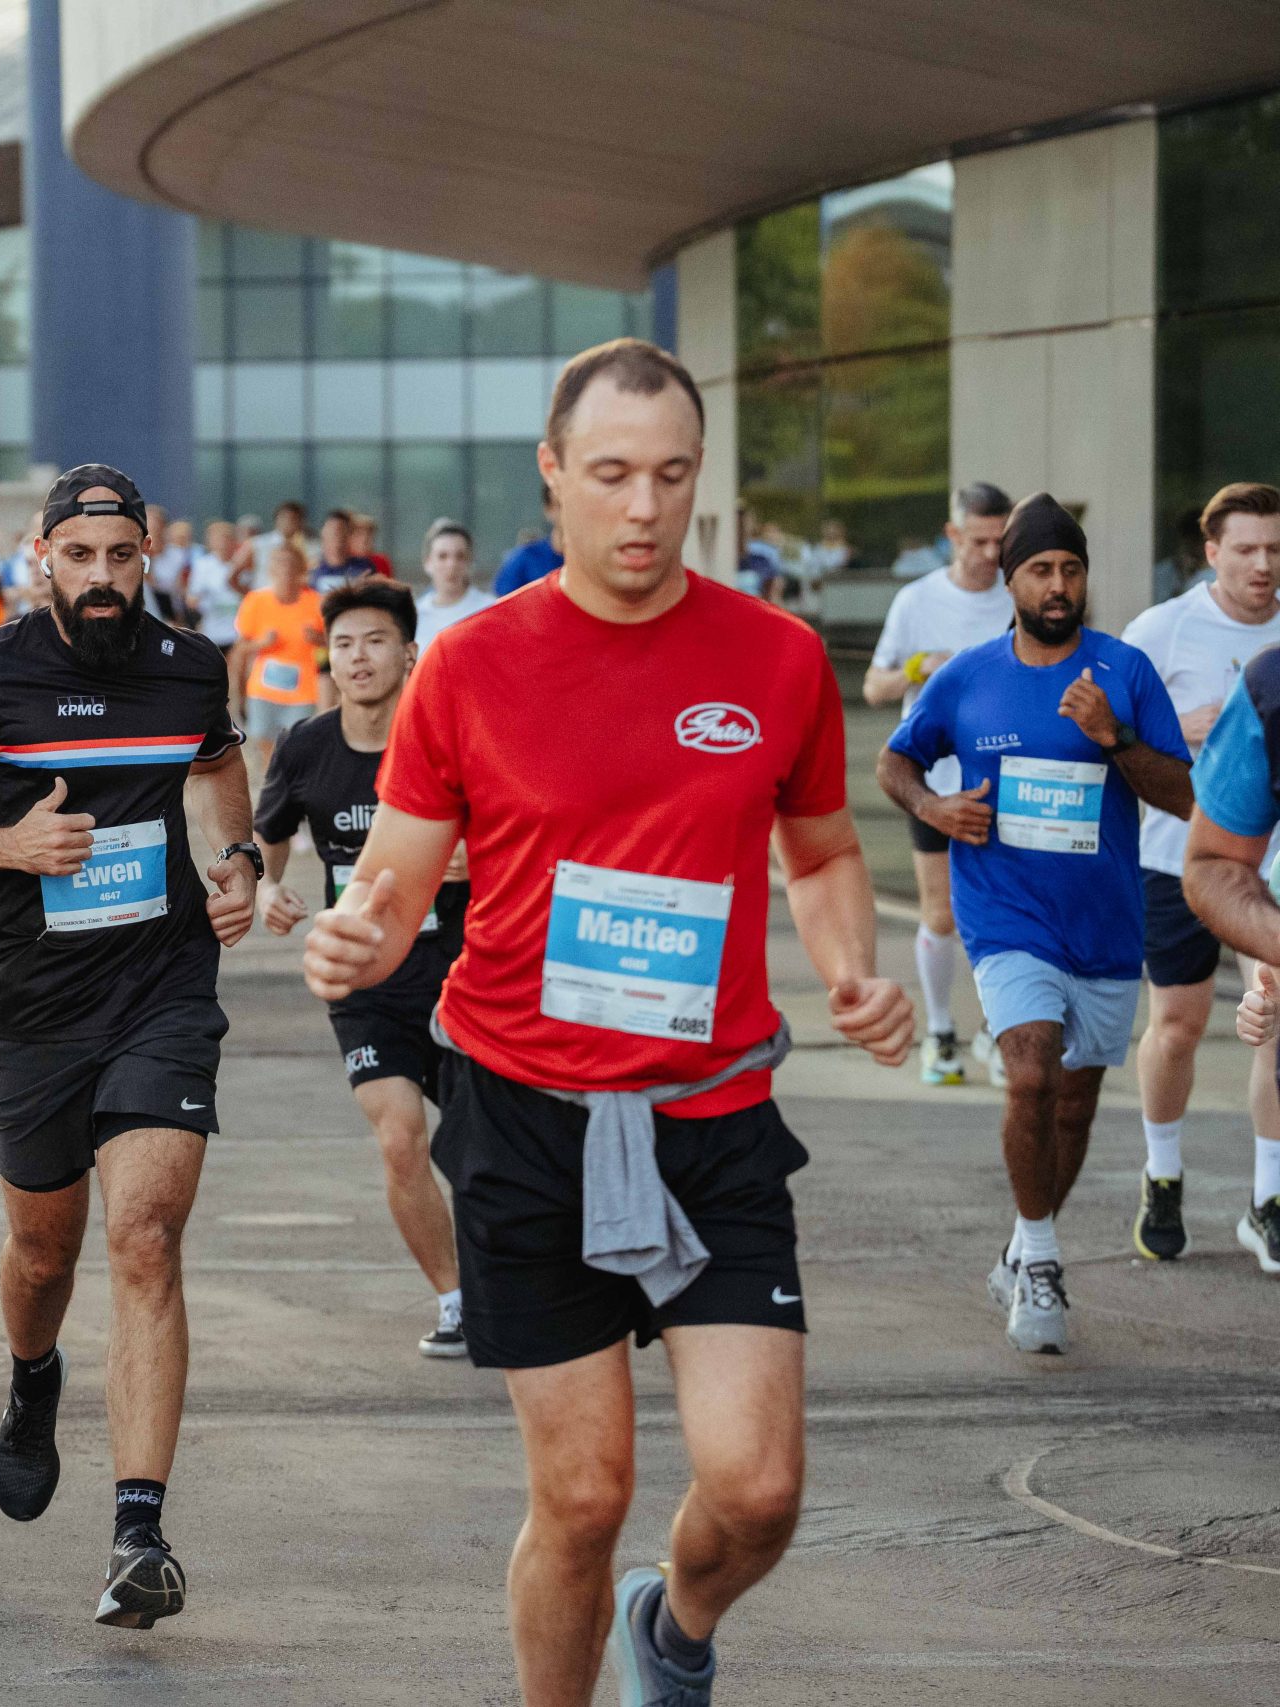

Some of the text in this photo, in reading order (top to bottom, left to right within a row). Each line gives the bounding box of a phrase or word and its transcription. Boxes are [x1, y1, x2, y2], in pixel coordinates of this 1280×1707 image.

[57, 703, 105, 717] KPMG
[976, 733, 1019, 746] CITCO
[1017, 781, 1085, 809] Harpal
[333, 804, 374, 832] elli
[72, 860, 142, 889] Ewen
[99, 891, 121, 902] 4647
[576, 907, 699, 957] Matteo
[668, 1015, 708, 1036] 4085
[117, 1493, 160, 1506] KPMG
